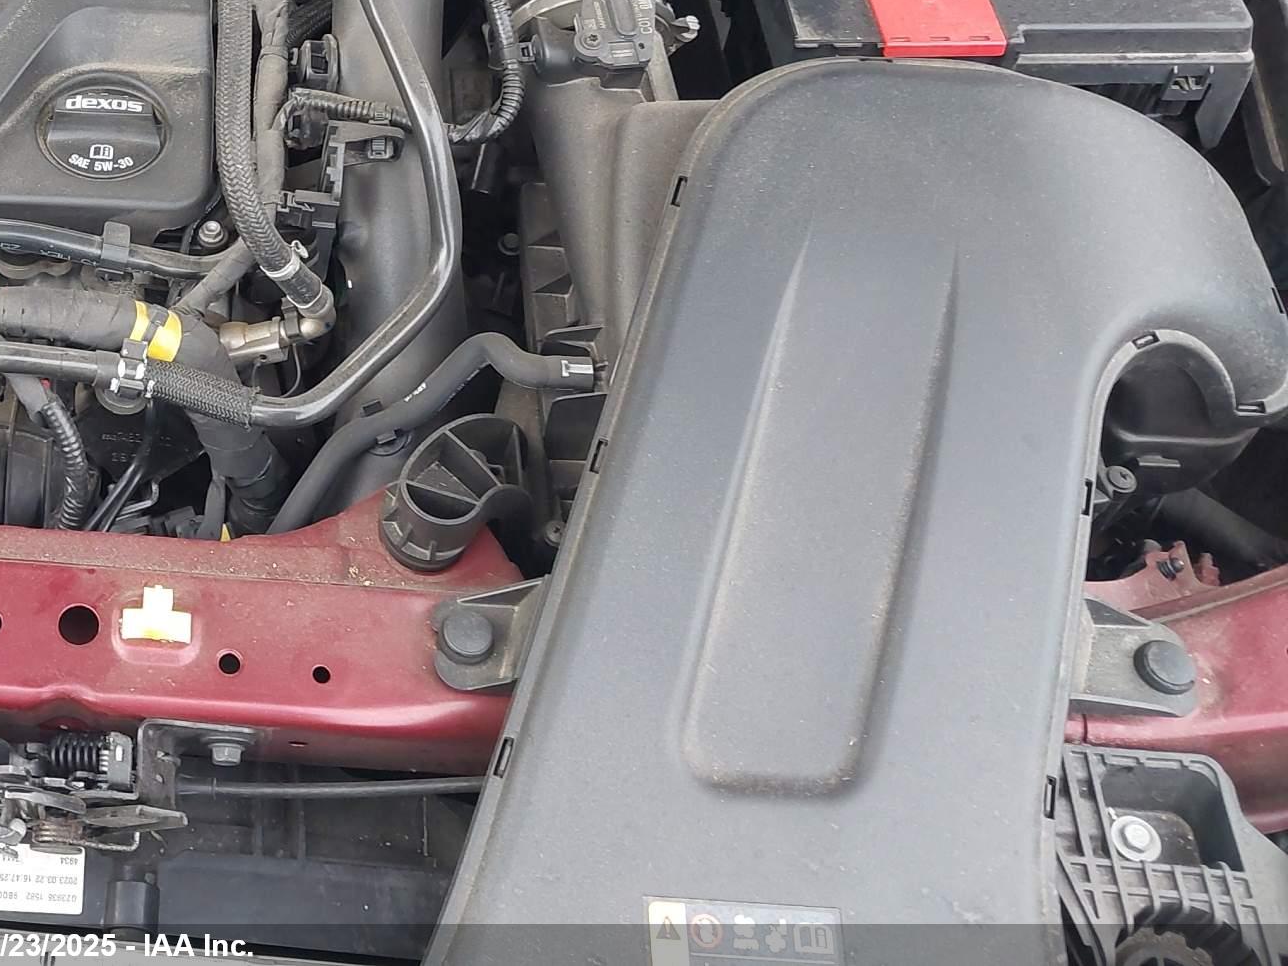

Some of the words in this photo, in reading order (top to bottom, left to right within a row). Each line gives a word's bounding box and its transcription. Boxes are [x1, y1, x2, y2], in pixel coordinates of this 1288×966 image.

[65, 94, 145, 113] dexos
[68, 153, 90, 169] SAE
[94, 156, 134, 172] 5W-30
